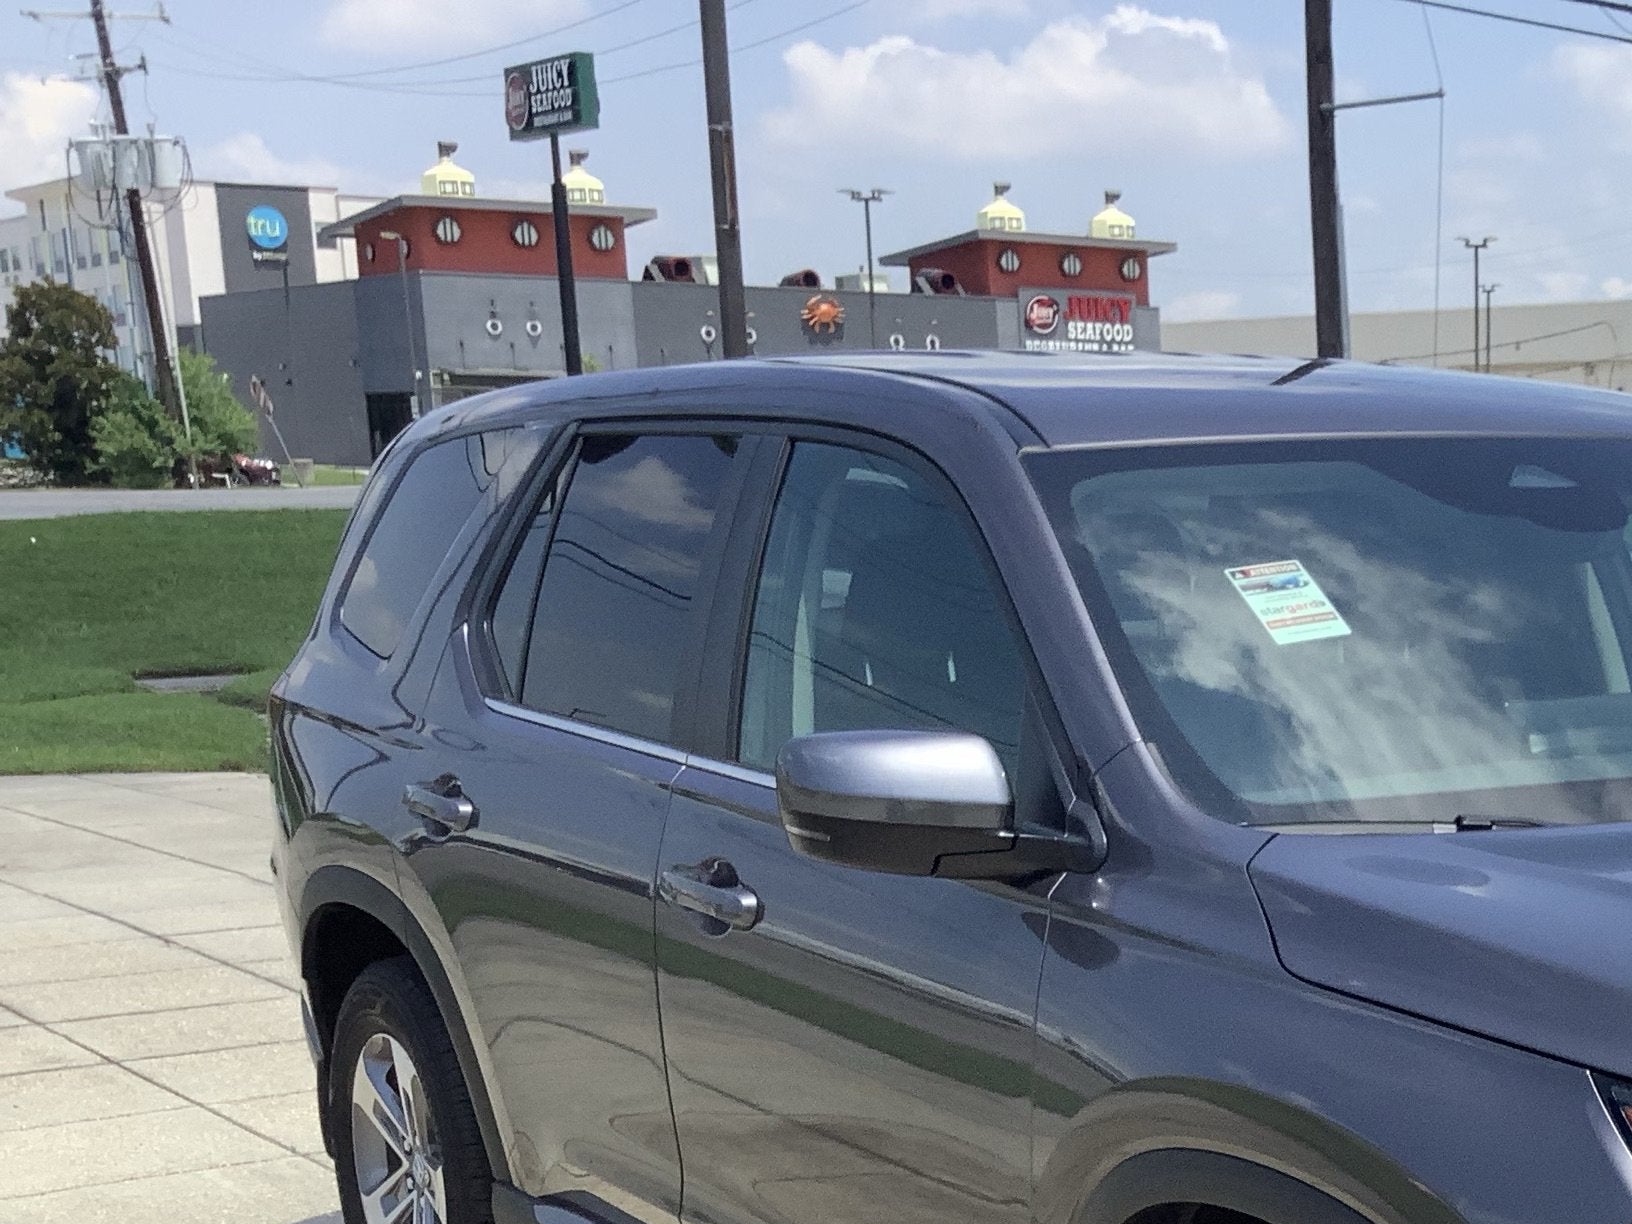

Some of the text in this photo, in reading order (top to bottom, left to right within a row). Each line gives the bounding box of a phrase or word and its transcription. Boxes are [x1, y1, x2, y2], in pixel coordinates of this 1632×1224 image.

[529, 58, 570, 93] JUICY
[531, 88, 573, 114] SEAFOOD
[247, 215, 280, 237] tru
[1063, 295, 1132, 323] JUICY
[1067, 321, 1133, 342] SEAFOOD
[1249, 563, 1299, 577] ATTENTION
